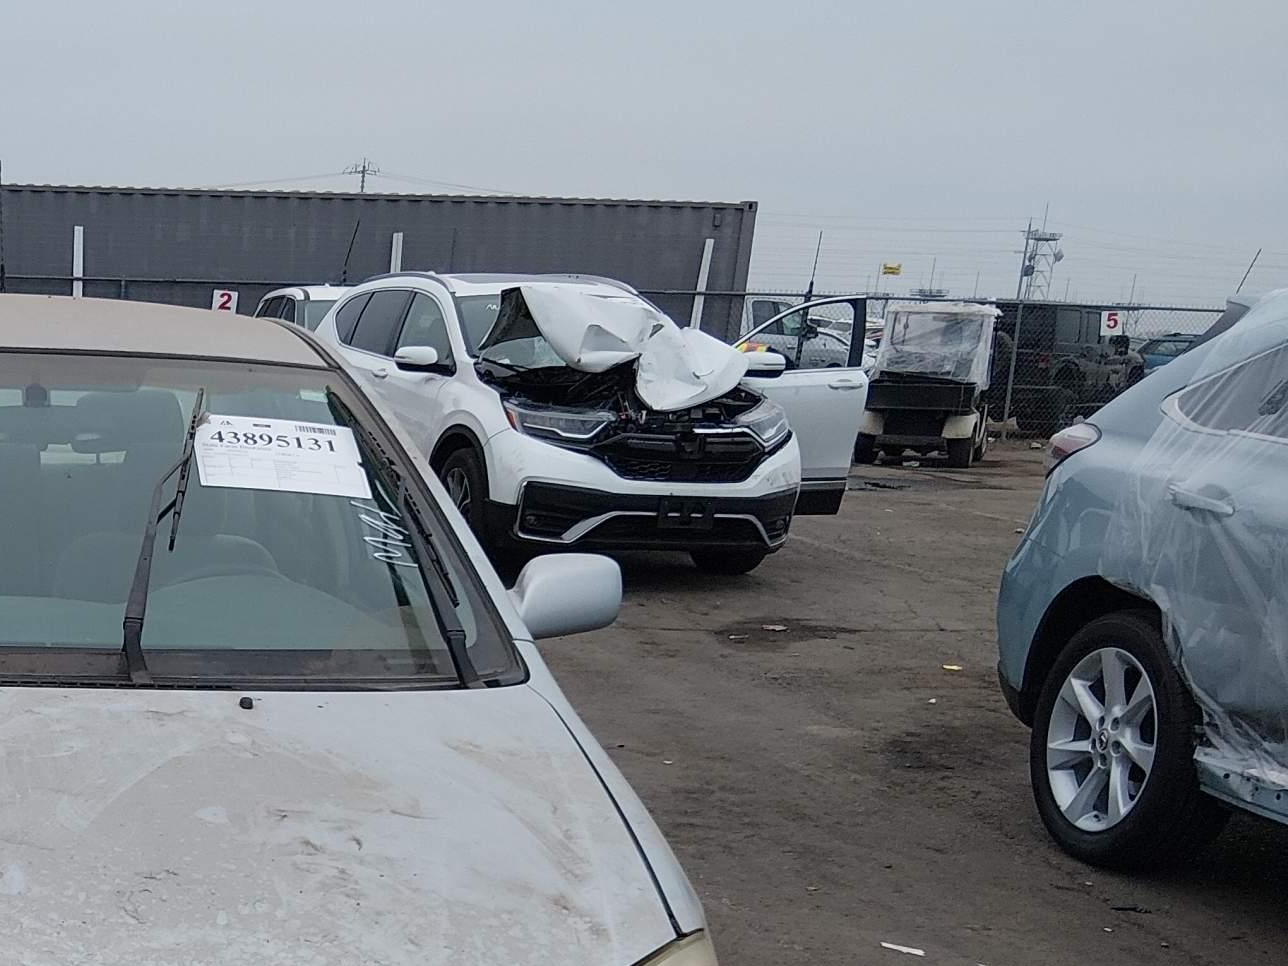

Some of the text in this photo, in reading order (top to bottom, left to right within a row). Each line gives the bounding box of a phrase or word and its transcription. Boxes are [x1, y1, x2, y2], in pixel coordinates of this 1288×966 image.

[218, 292, 232, 310] 2
[1106, 312, 1119, 329] 5
[210, 430, 337, 453] 43895131
